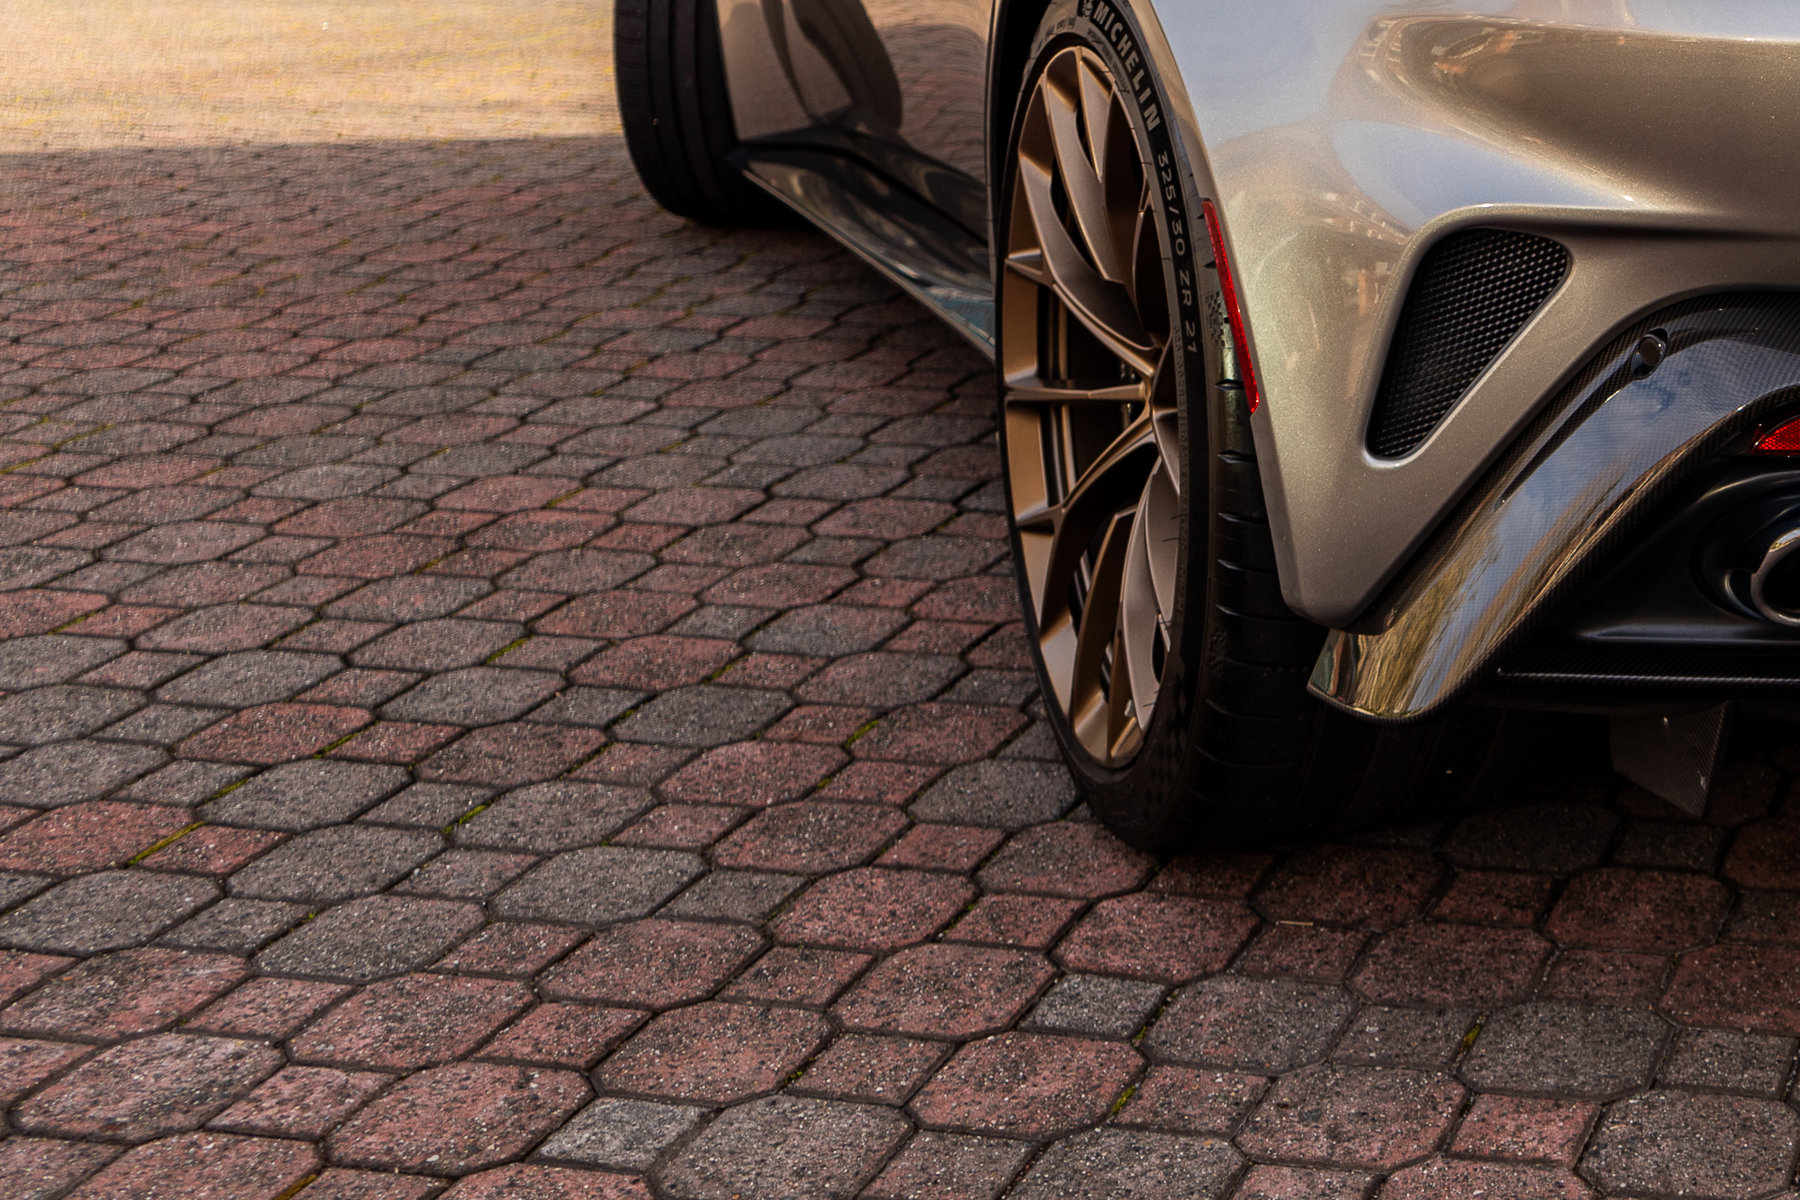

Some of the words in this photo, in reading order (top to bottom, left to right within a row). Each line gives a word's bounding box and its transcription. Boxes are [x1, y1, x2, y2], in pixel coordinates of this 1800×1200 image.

[1092, 0, 1160, 133] MICHELIN
[1156, 151, 1186, 258] 325/30
[1179, 269, 1193, 307] ZR
[1184, 318, 1198, 354] 21
